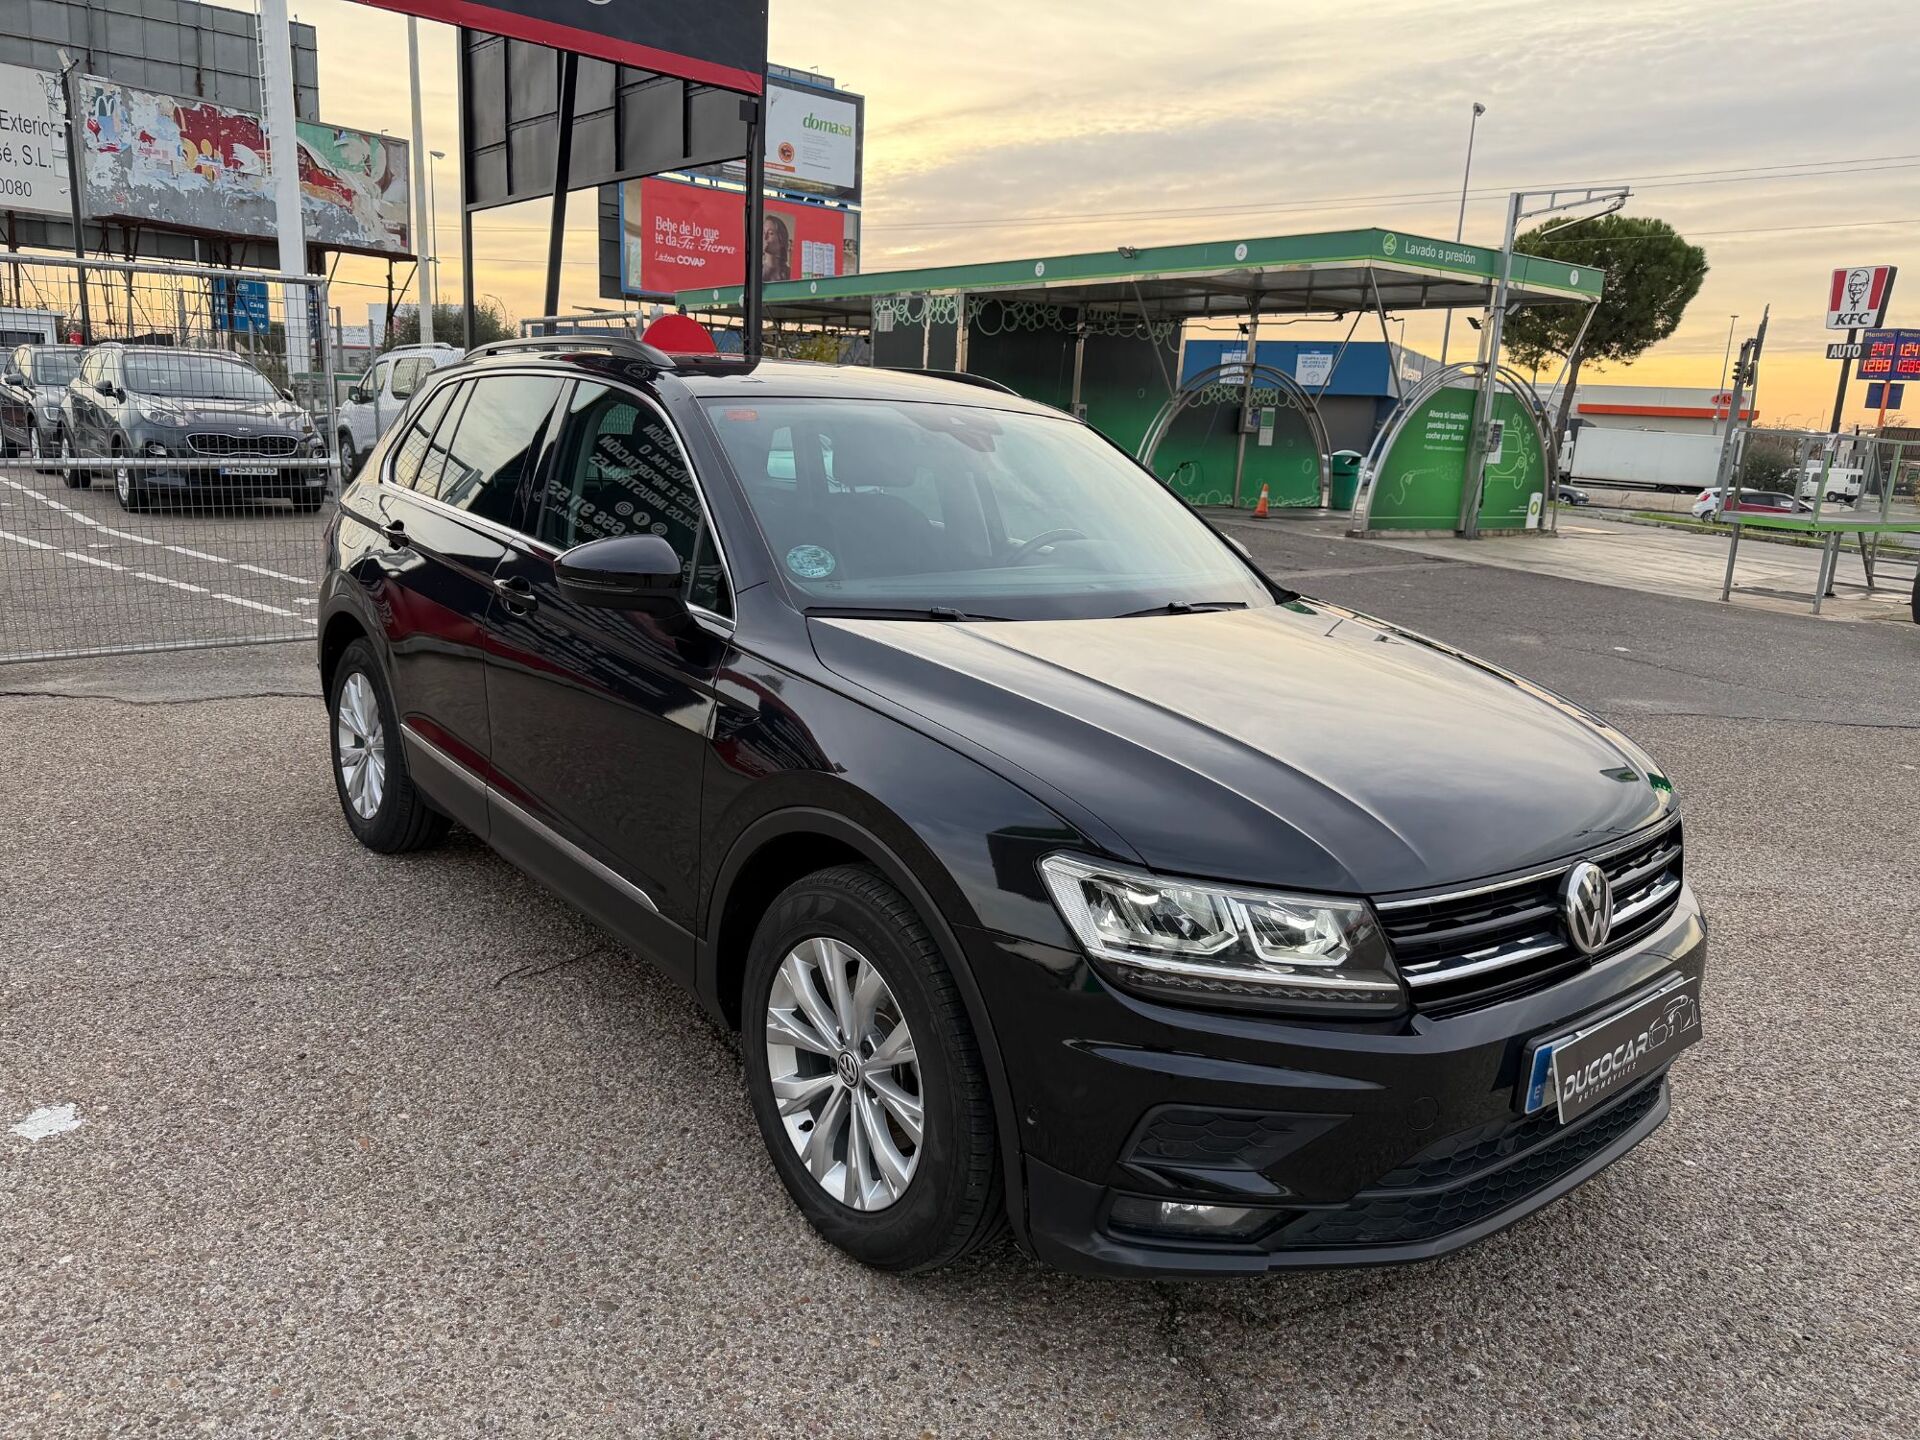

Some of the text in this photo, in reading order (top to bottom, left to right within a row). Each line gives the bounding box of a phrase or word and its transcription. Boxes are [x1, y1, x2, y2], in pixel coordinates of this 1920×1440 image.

[803, 113, 853, 137] domasa
[22, 145, 51, 168] S.L.
[655, 216, 719, 241] Bebe de lo que
[655, 232, 664, 245] te
[665, 231, 677, 247] da
[677, 255, 706, 267] COVAP
[1405, 240, 1476, 265] Lavado a presión
[1834, 312, 1870, 326] KFC
[1829, 343, 1862, 359] AUTO
[1429, 410, 1443, 418] Ahora
[1563, 1032, 1648, 1103] DUCOCAR
